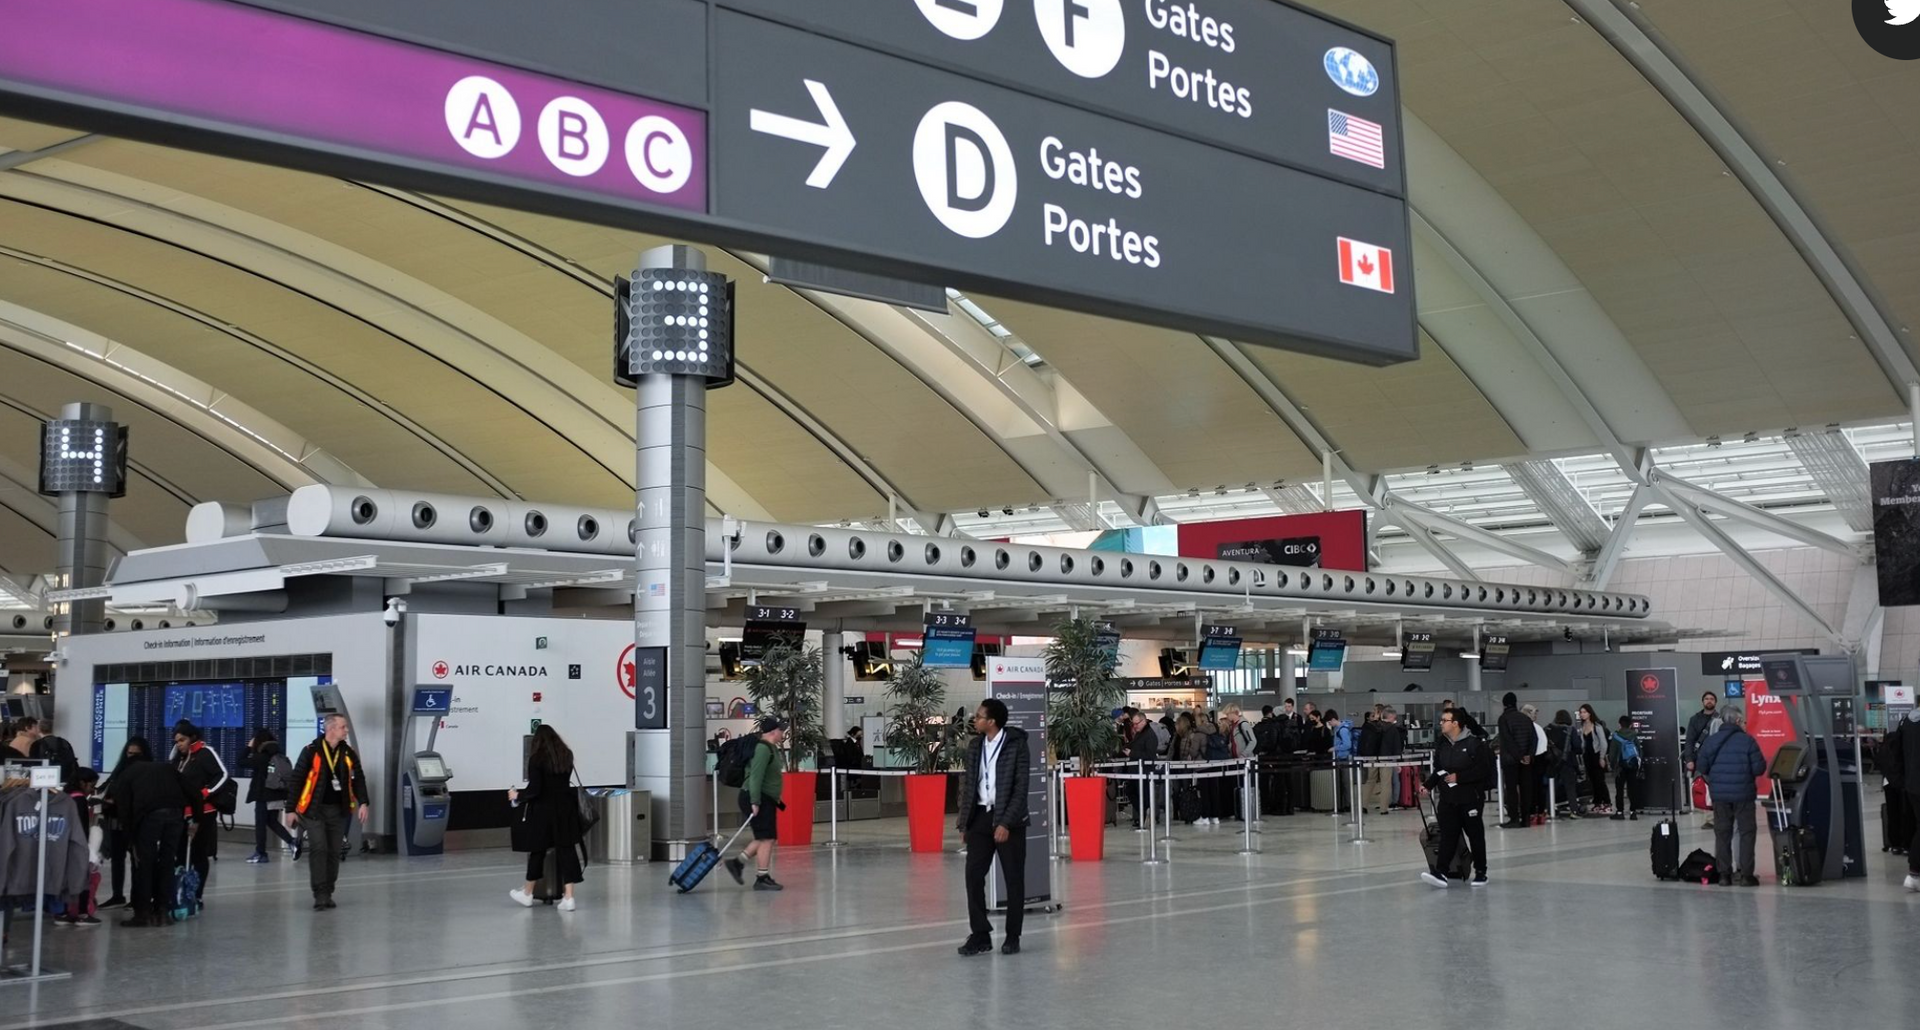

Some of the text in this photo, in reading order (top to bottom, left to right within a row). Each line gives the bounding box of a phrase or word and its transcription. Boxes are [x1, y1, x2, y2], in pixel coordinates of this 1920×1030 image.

[1146, 0, 1236, 53] Gates
[1149, 50, 1252, 118] Portes
[464, 92, 674, 179] A B C
[944, 121, 996, 212] D
[1040, 136, 1142, 199] Gates
[1044, 203, 1161, 268] Portes
[652, 280, 709, 363] 3
[61, 427, 103, 483] 4
[1222, 547, 1260, 557] AVENTURA
[1284, 544, 1306, 555] CIBC
[144, 640, 163, 650] Check-in
[164, 638, 190, 649] Information
[194, 637, 221, 646] Information
[223, 634, 265, 646] d'enregistrement
[455, 664, 548, 677] AIR CANADA
[643, 657, 656, 665] Aisle
[643, 667, 656, 677] Allée
[643, 686, 656, 719] 3
[996, 692, 1016, 700] Check-in
[1751, 693, 1781, 706] Lynx
